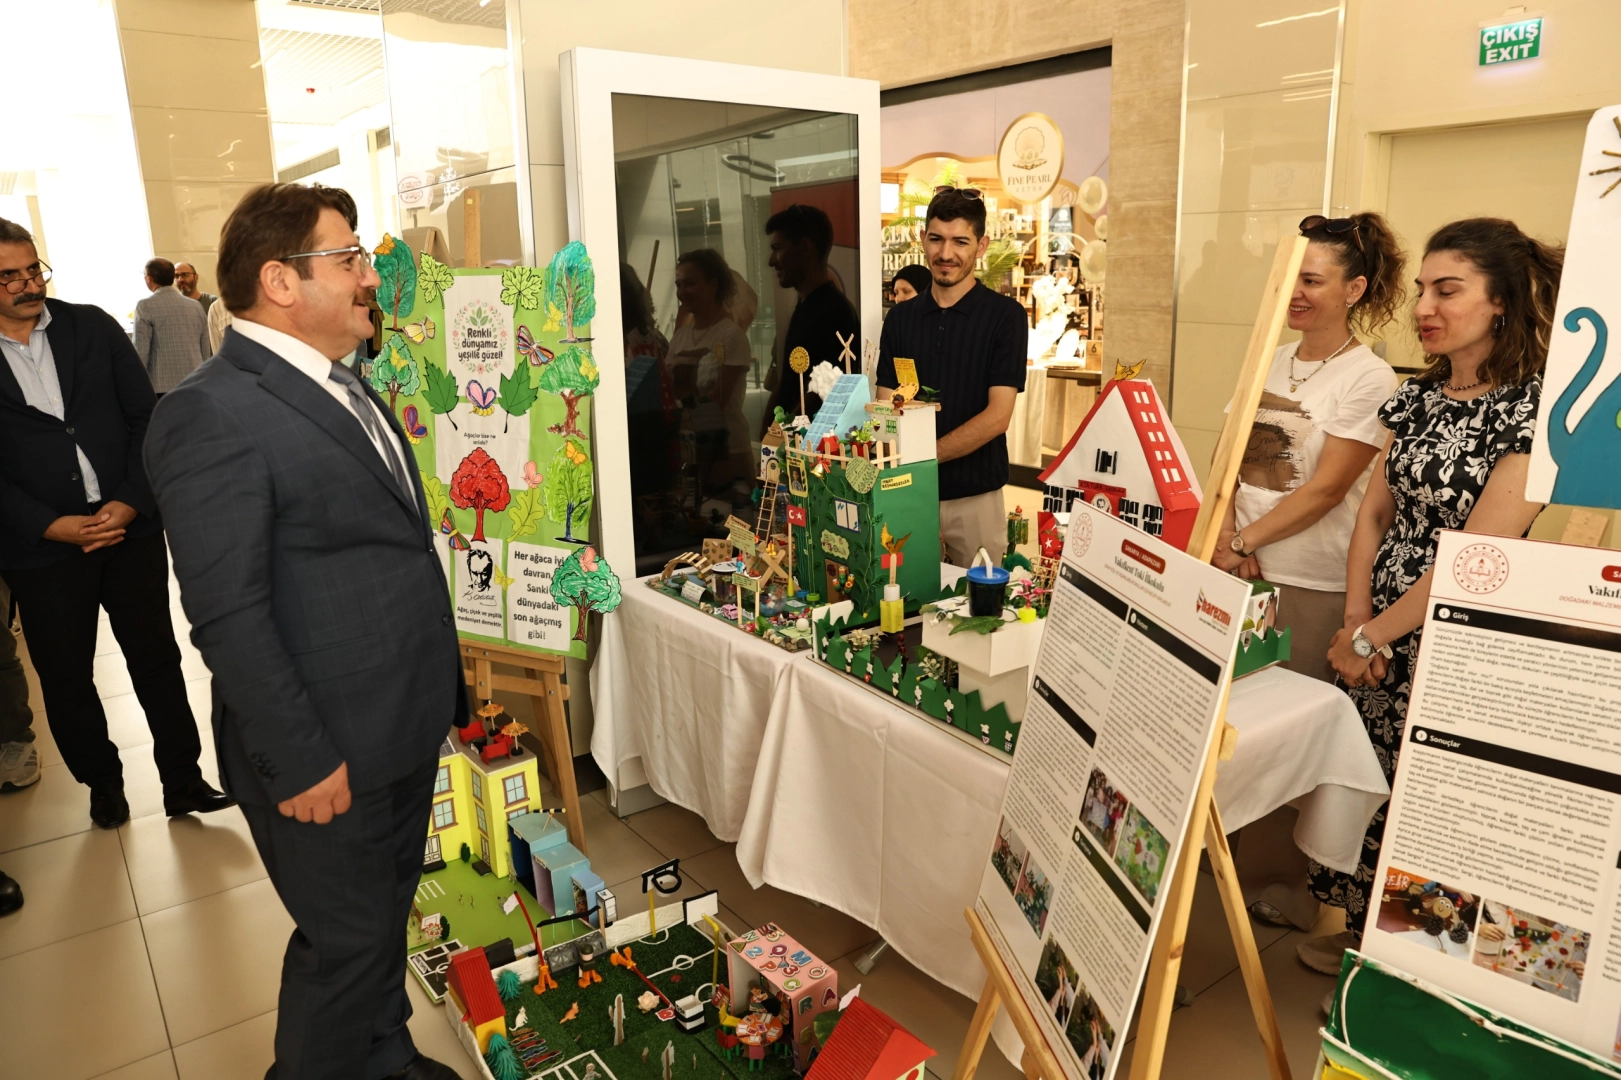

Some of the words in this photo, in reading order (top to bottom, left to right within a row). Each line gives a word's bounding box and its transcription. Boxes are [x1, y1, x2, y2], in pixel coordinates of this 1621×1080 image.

[1482, 23, 1539, 49] ÇIKIŞ
[1485, 43, 1533, 64] EXIT
[1007, 176, 1025, 186] FINE
[1026, 174, 1052, 184] PEARL
[467, 327, 492, 338] Renkli
[461, 338, 498, 351] dünyamız
[458, 349, 480, 361] yeşille
[481, 349, 503, 361] güzel!
[514, 551, 528, 560] Her
[530, 553, 552, 564] ağaca
[527, 584, 548, 594] Sanki
[513, 612, 527, 622] son
[529, 615, 562, 629] ağaçmış
[1452, 611, 1469, 622] Giriş
[528, 630, 546, 640] gibi!
[1429, 735, 1461, 748] Sonuçlar
